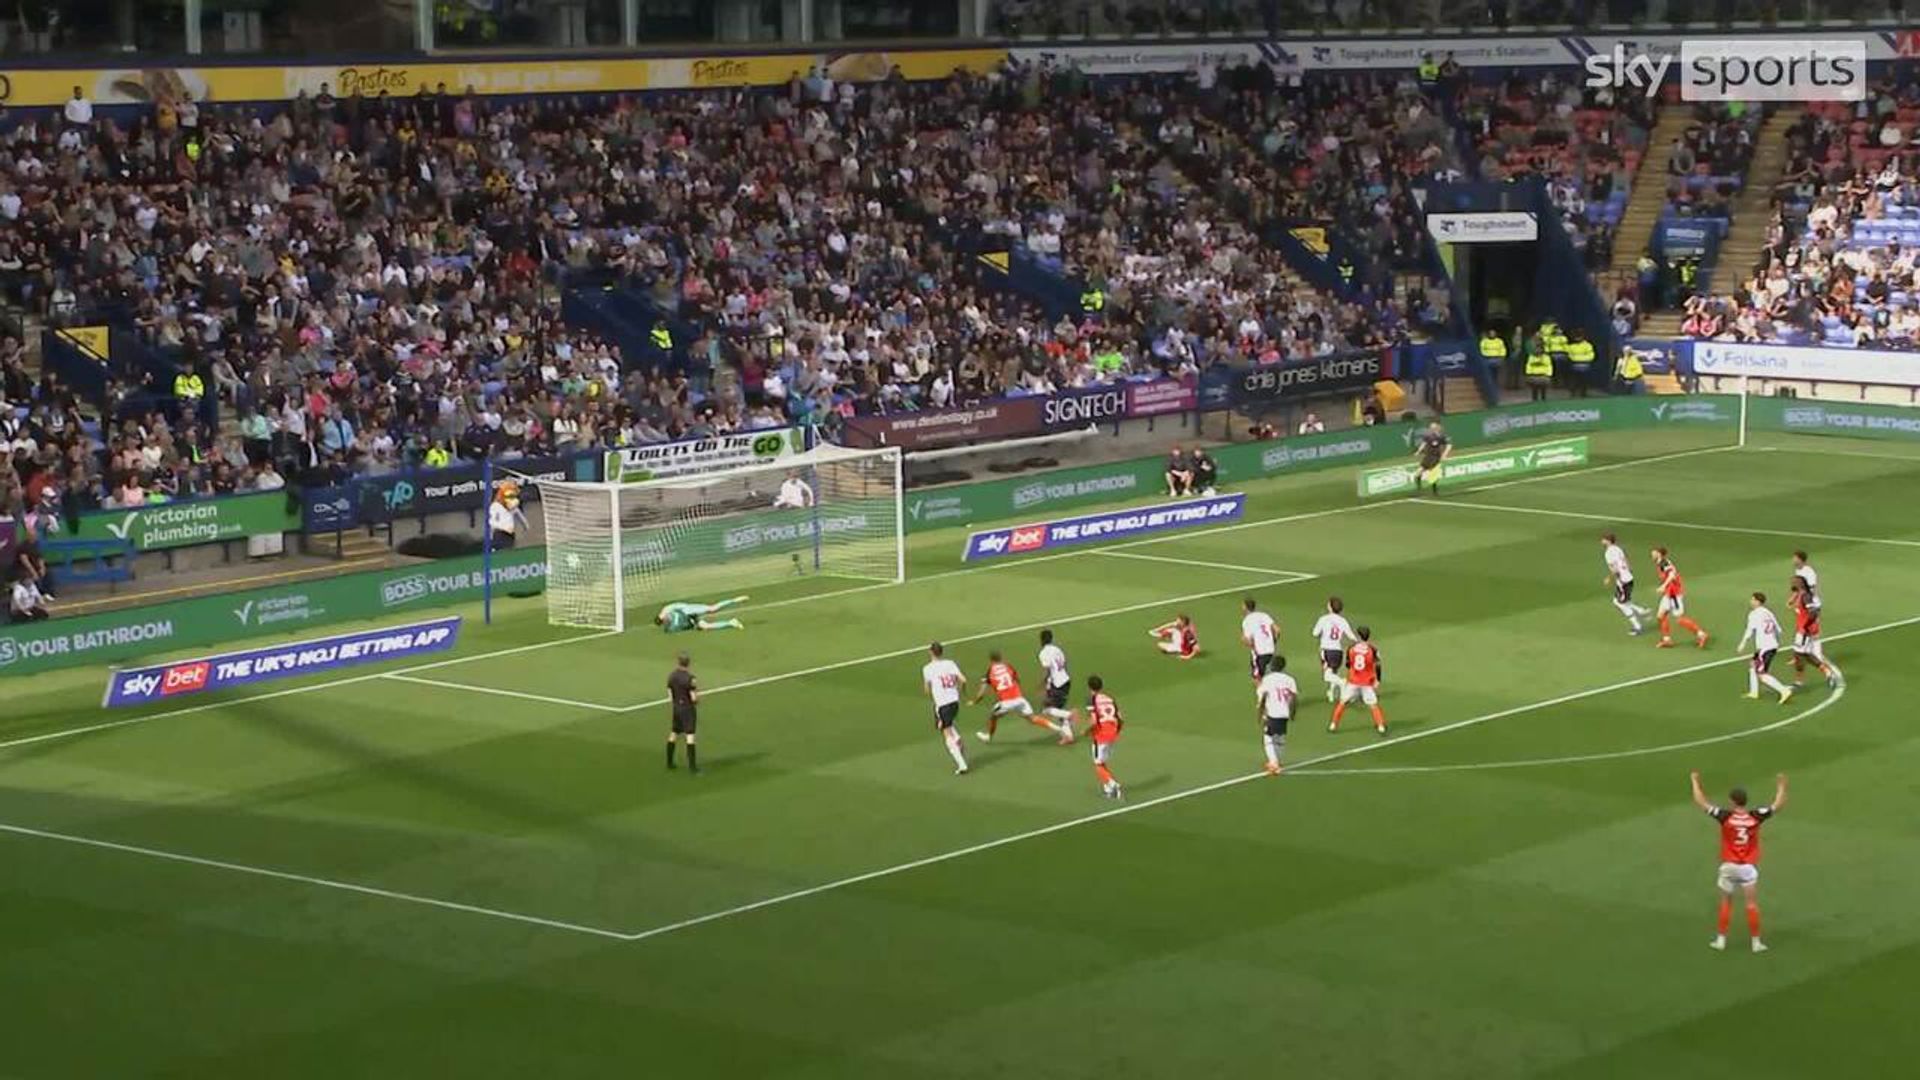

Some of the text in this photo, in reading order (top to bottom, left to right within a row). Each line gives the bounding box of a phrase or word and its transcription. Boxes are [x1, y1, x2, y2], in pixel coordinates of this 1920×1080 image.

[339, 69, 407, 92] Pasties
[1045, 391, 1126, 423] SIGNTECH
[753, 434, 782, 454] GO
[144, 504, 217, 526] victorian
[978, 536, 1008, 553] sky
[1012, 528, 1041, 545] bet
[1052, 526, 1077, 540] THE
[1208, 502, 1236, 516] APP
[384, 578, 425, 602] BOSS
[428, 574, 469, 593] YOUR
[19, 637, 69, 658] YOUR
[74, 620, 173, 650] BATHROOM
[1330, 626, 1341, 641] 8
[123, 674, 161, 697] sky
[166, 667, 204, 687] bet
[216, 658, 253, 680] THE
[254, 651, 296, 673] UK'S
[338, 634, 414, 660] BETTING
[414, 628, 449, 647] APP
[1354, 654, 1366, 671] 8
[1733, 826, 1750, 846] 3
